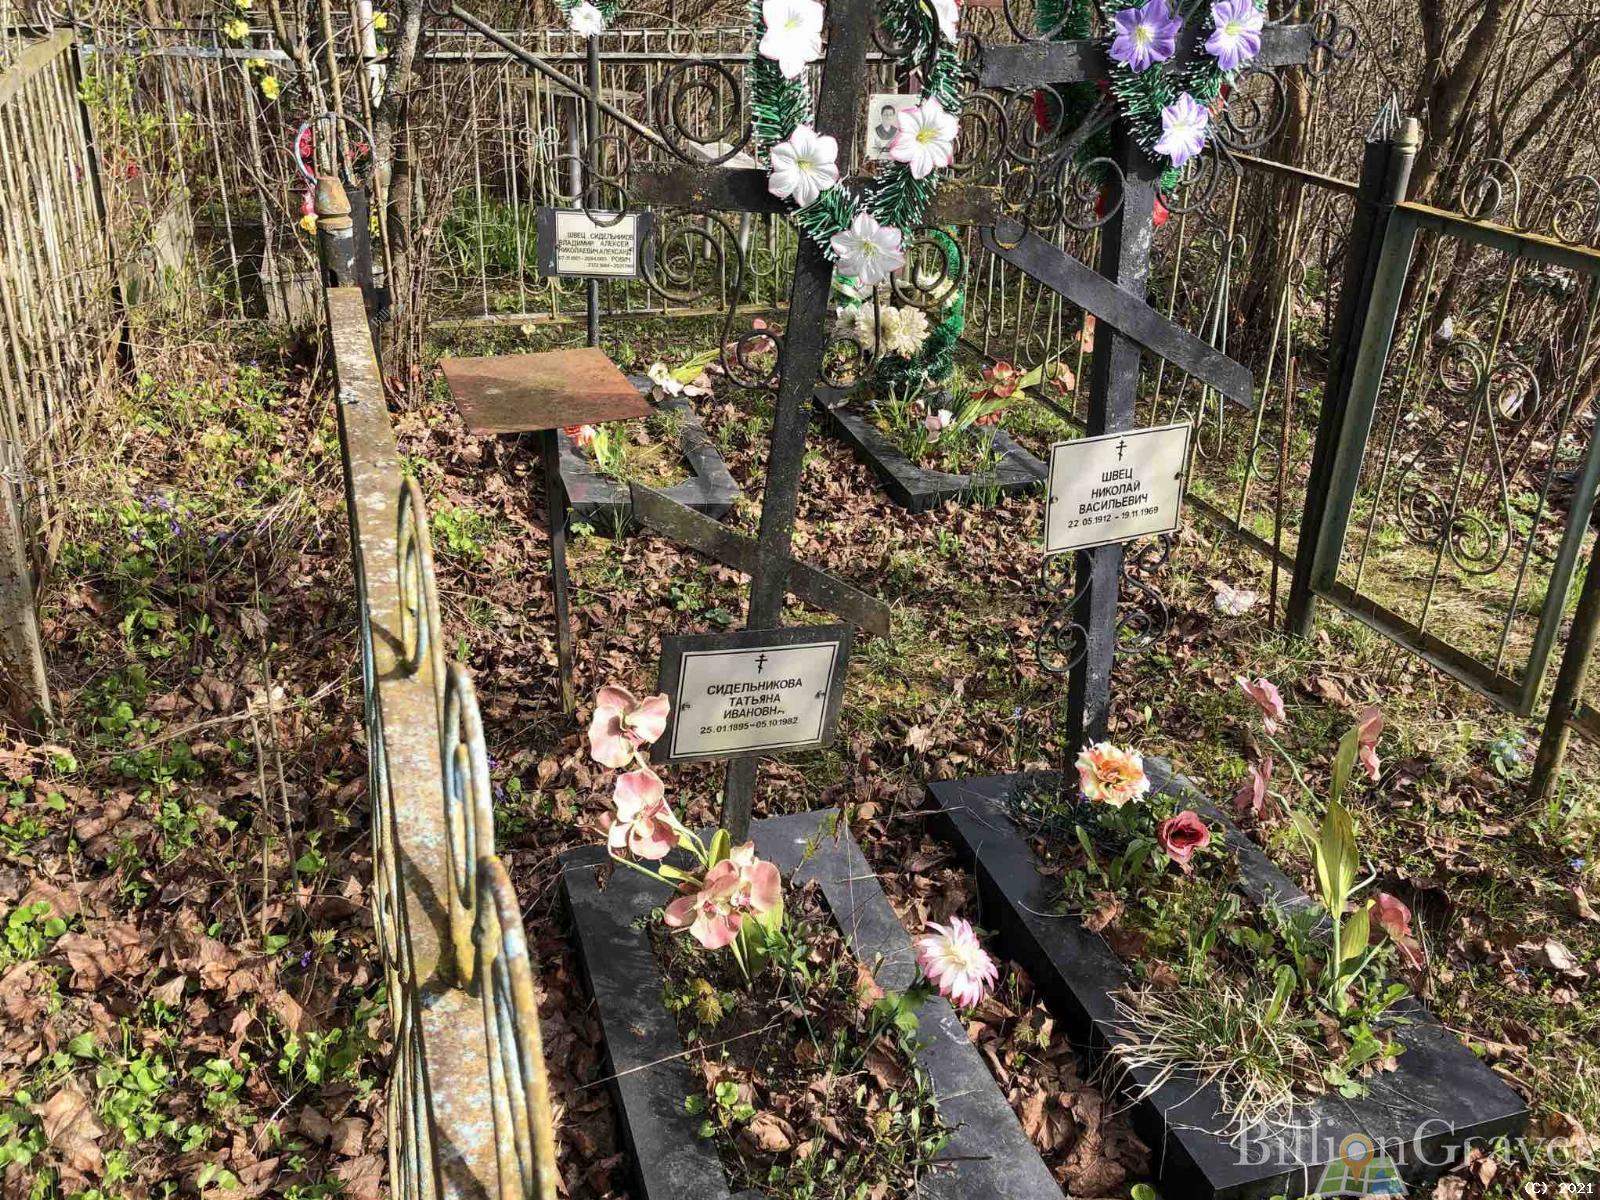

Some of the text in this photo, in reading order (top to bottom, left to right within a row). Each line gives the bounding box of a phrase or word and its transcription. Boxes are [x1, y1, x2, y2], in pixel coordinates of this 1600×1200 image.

[1101, 468, 1133, 482] ШВЕЦ
[1091, 480, 1141, 499] НИКОЛАЙ
[1079, 493, 1148, 515] ВАСИЛЬЕВИЧ
[707, 678, 803, 696] СИДЕЛЬНИКОВА
[729, 694, 781, 707] ТАТЬЯНА
